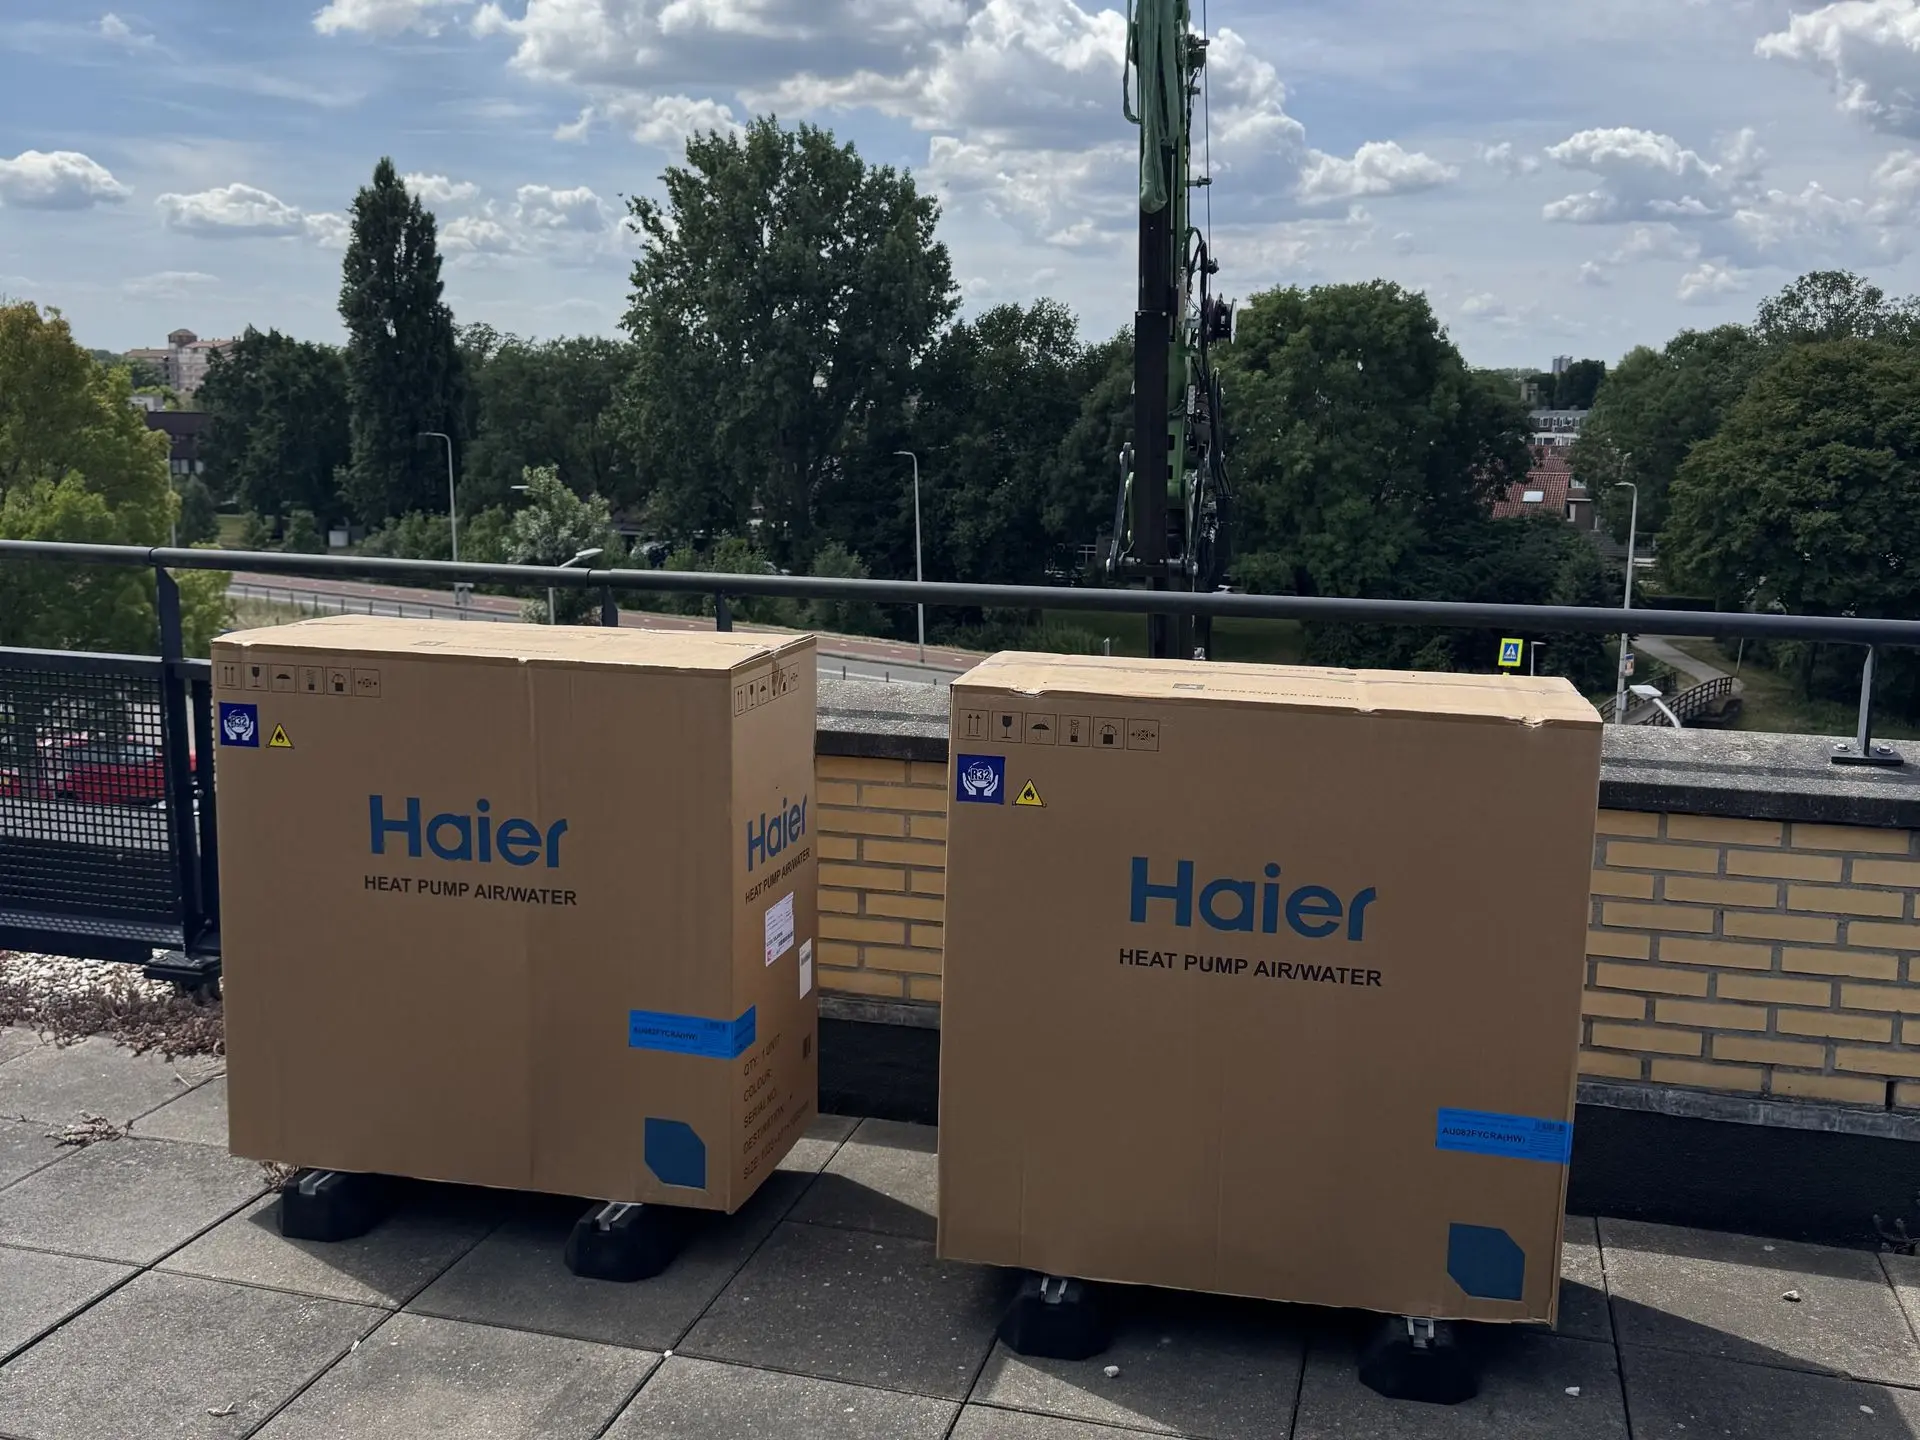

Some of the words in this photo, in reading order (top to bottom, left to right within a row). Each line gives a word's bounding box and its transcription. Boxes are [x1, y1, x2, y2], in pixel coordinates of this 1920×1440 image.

[971, 768, 992, 781] R32
[369, 795, 568, 868] Haier
[747, 794, 808, 872] Haier
[363, 874, 412, 893] HEAT
[417, 879, 470, 898] PUMP
[474, 883, 578, 906] AIR/WATER
[745, 882, 762, 905] HEAT
[763, 869, 781, 891] PUMP
[1130, 857, 1376, 941] Haier
[1119, 947, 1178, 969] HEAT
[1183, 954, 1249, 975] PUMP
[1253, 960, 1383, 988] AIR/WATER
